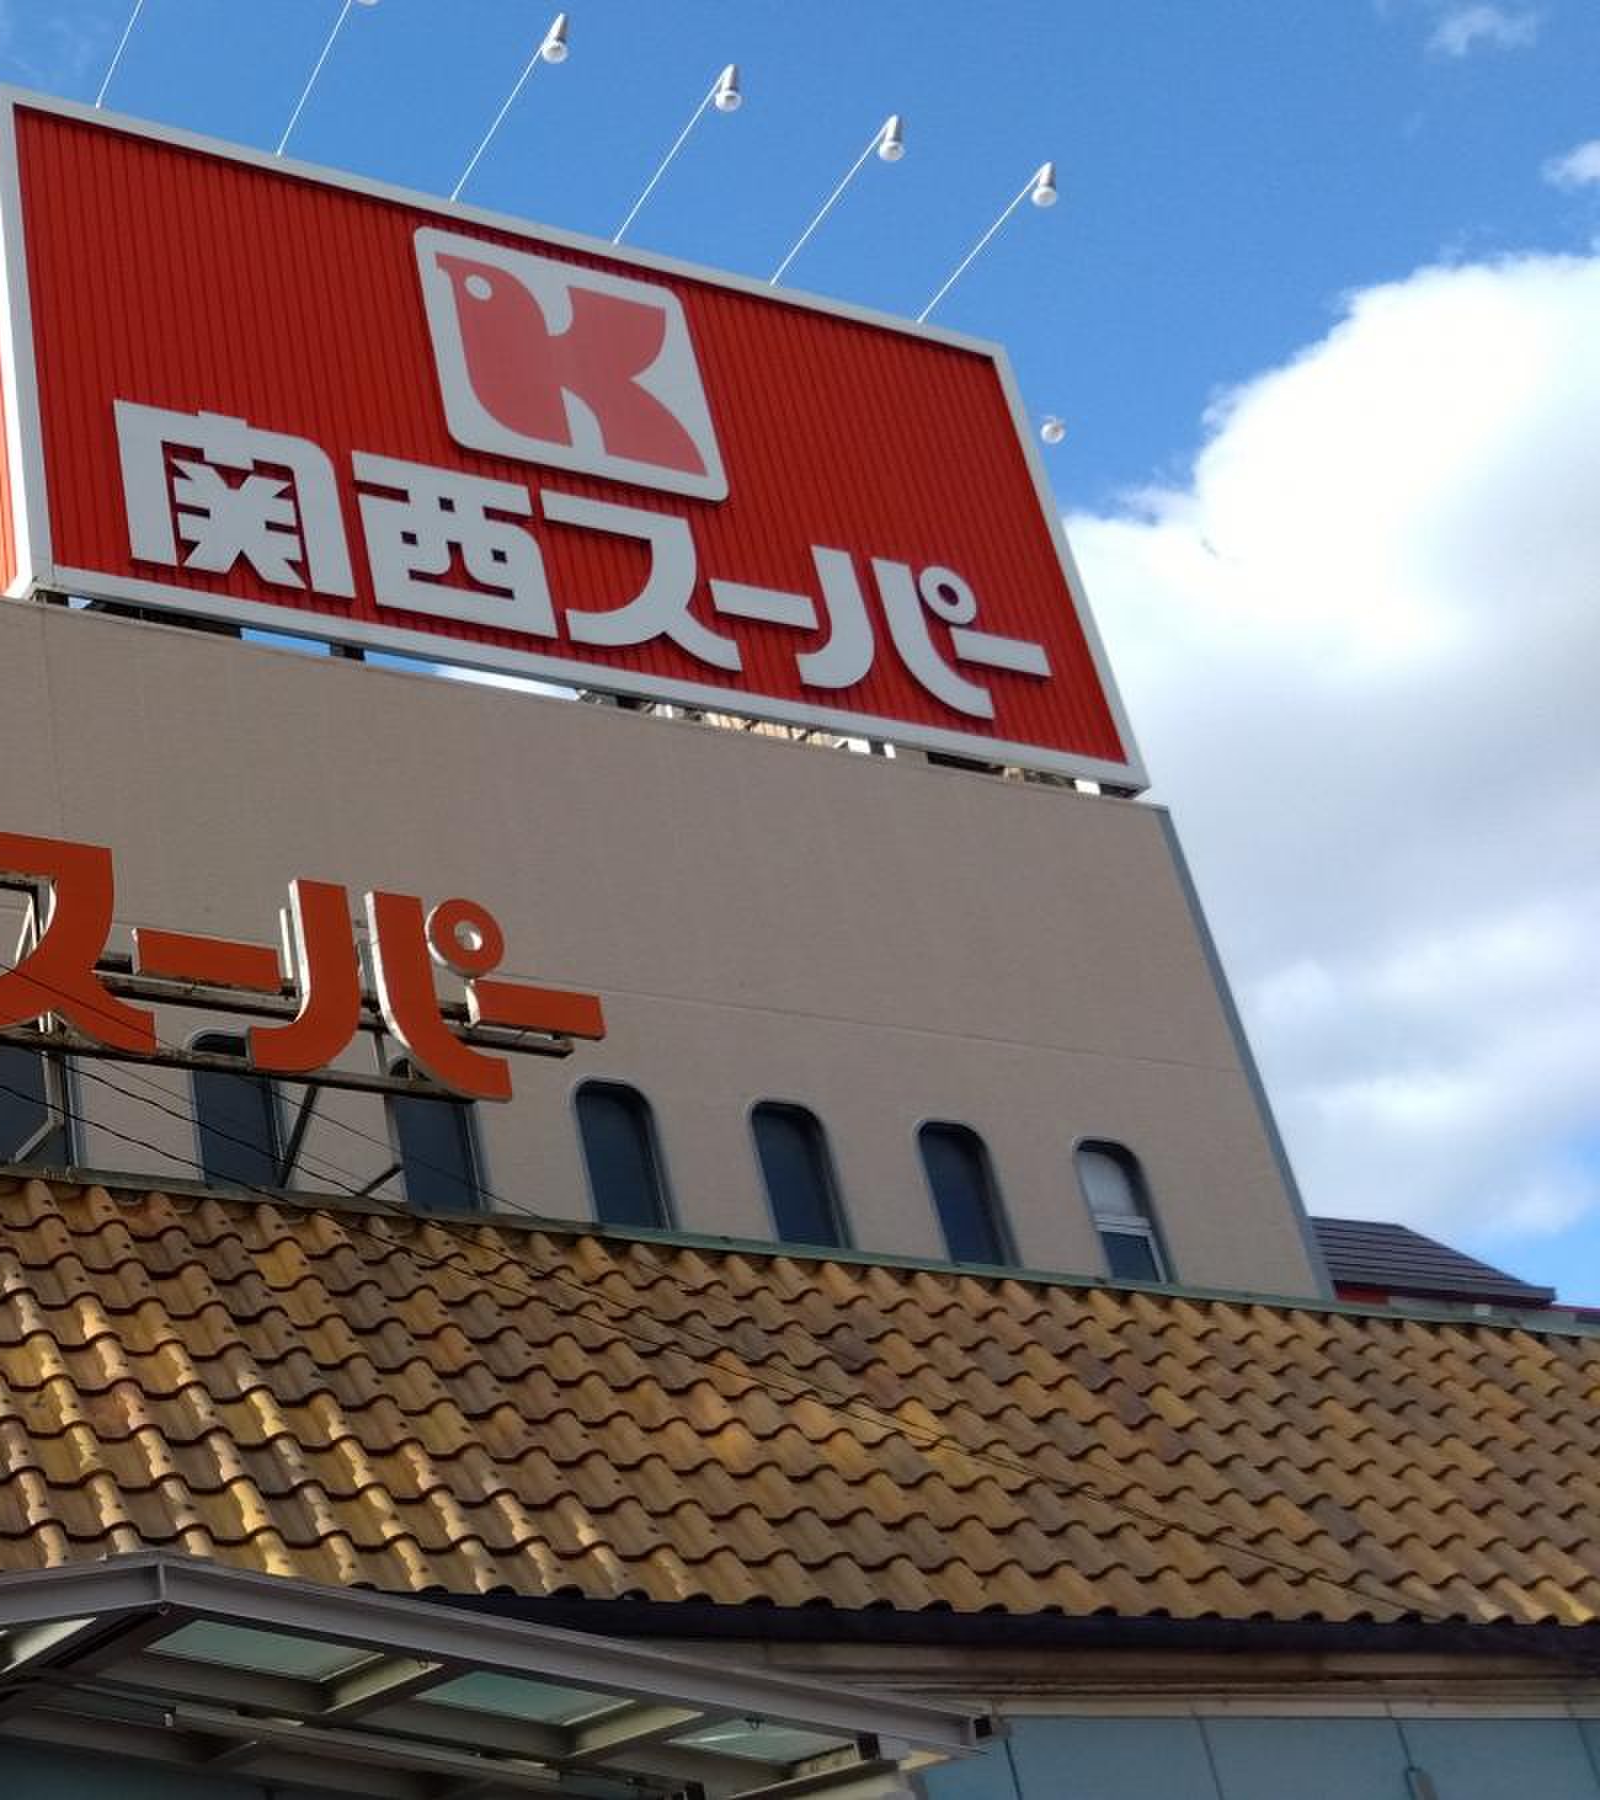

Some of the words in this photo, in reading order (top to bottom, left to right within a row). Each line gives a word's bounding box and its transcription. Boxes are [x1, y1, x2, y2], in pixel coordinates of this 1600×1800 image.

[112, 398, 1054, 720] 関西スーパー
